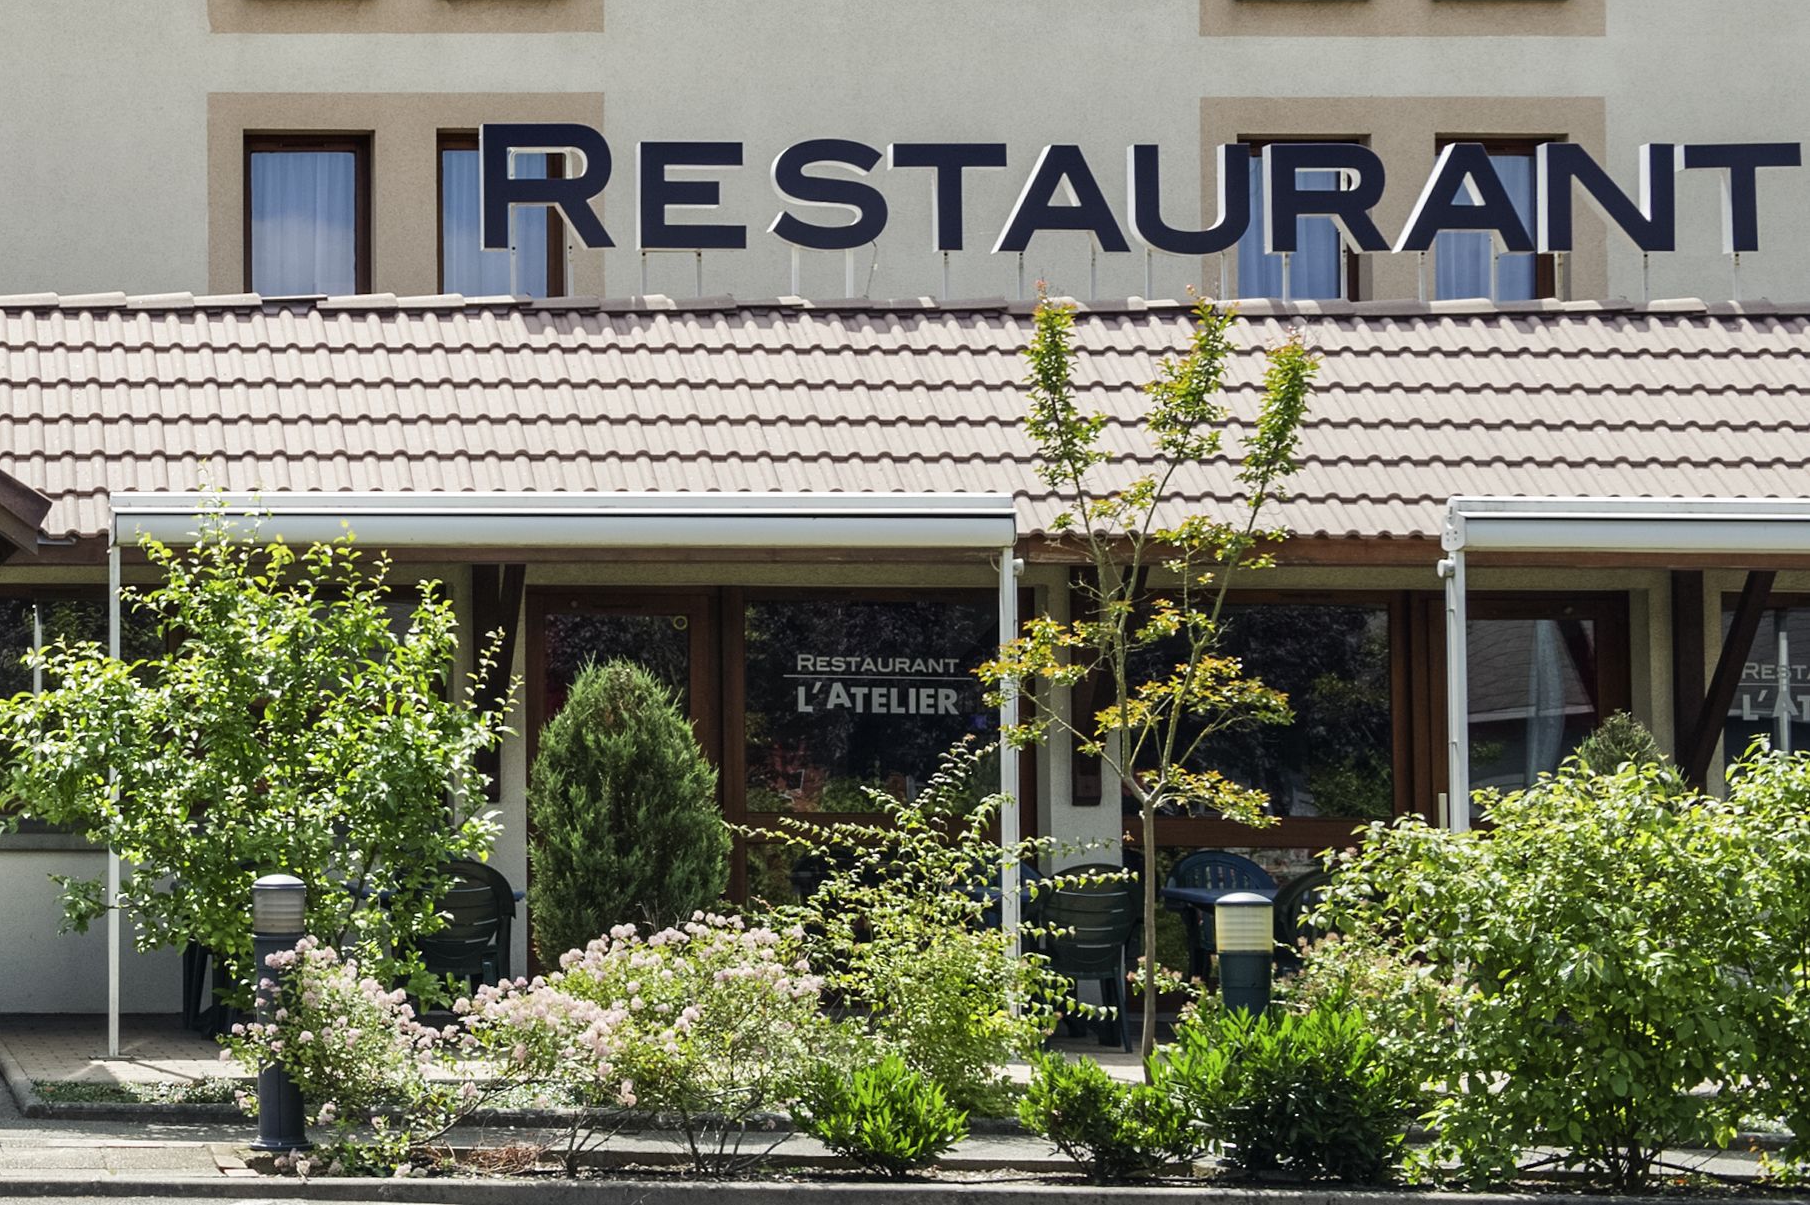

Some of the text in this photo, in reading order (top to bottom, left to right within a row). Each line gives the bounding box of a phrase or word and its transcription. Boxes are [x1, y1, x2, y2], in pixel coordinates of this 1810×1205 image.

[479, 122, 1803, 255] RESTAURANT
[796, 653, 960, 674] RESTAURANT
[1741, 662, 1810, 680] REST
[796, 681, 960, 716] L'ATELIER
